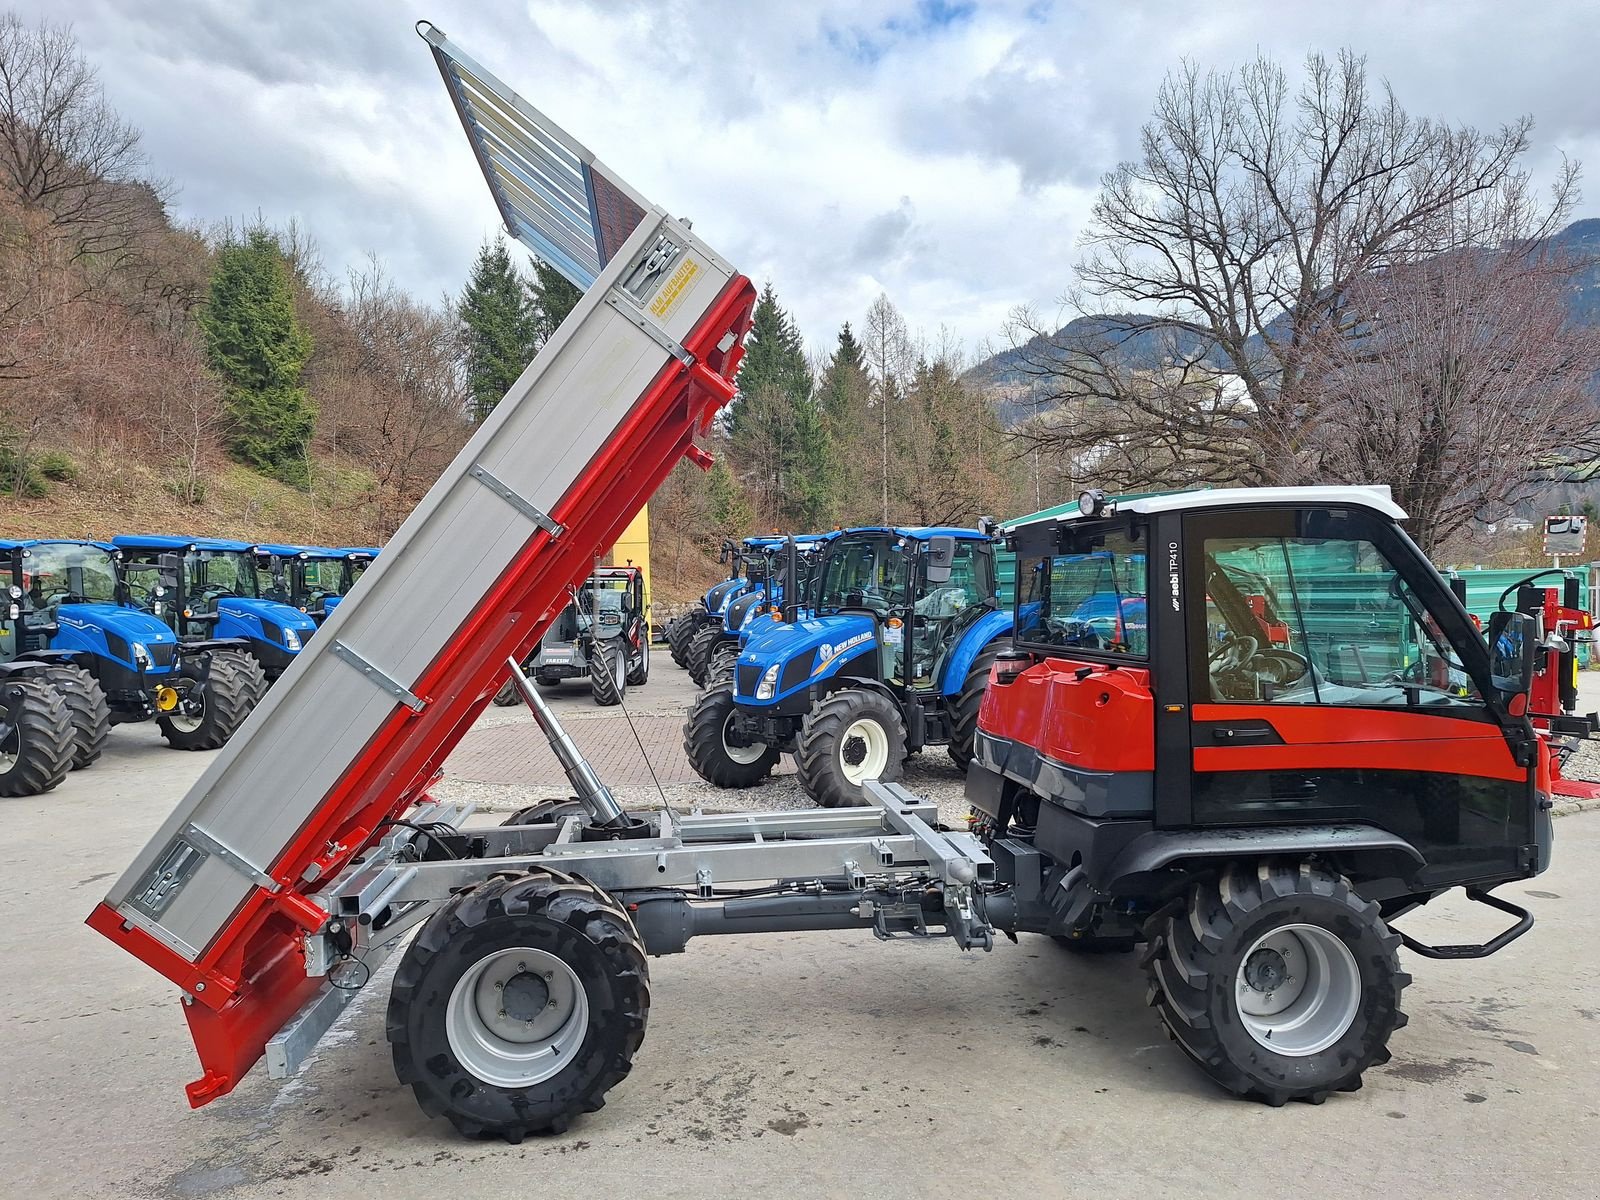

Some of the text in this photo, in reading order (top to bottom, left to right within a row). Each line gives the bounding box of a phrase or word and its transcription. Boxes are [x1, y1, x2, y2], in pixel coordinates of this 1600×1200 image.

[649, 296, 665, 315] HLM
[662, 258, 694, 299] AUFBAUTEN
[1168, 542, 1180, 596] aebi TP410
[834, 639, 849, 654] NEW
[847, 631, 872, 647] HOLLAND
